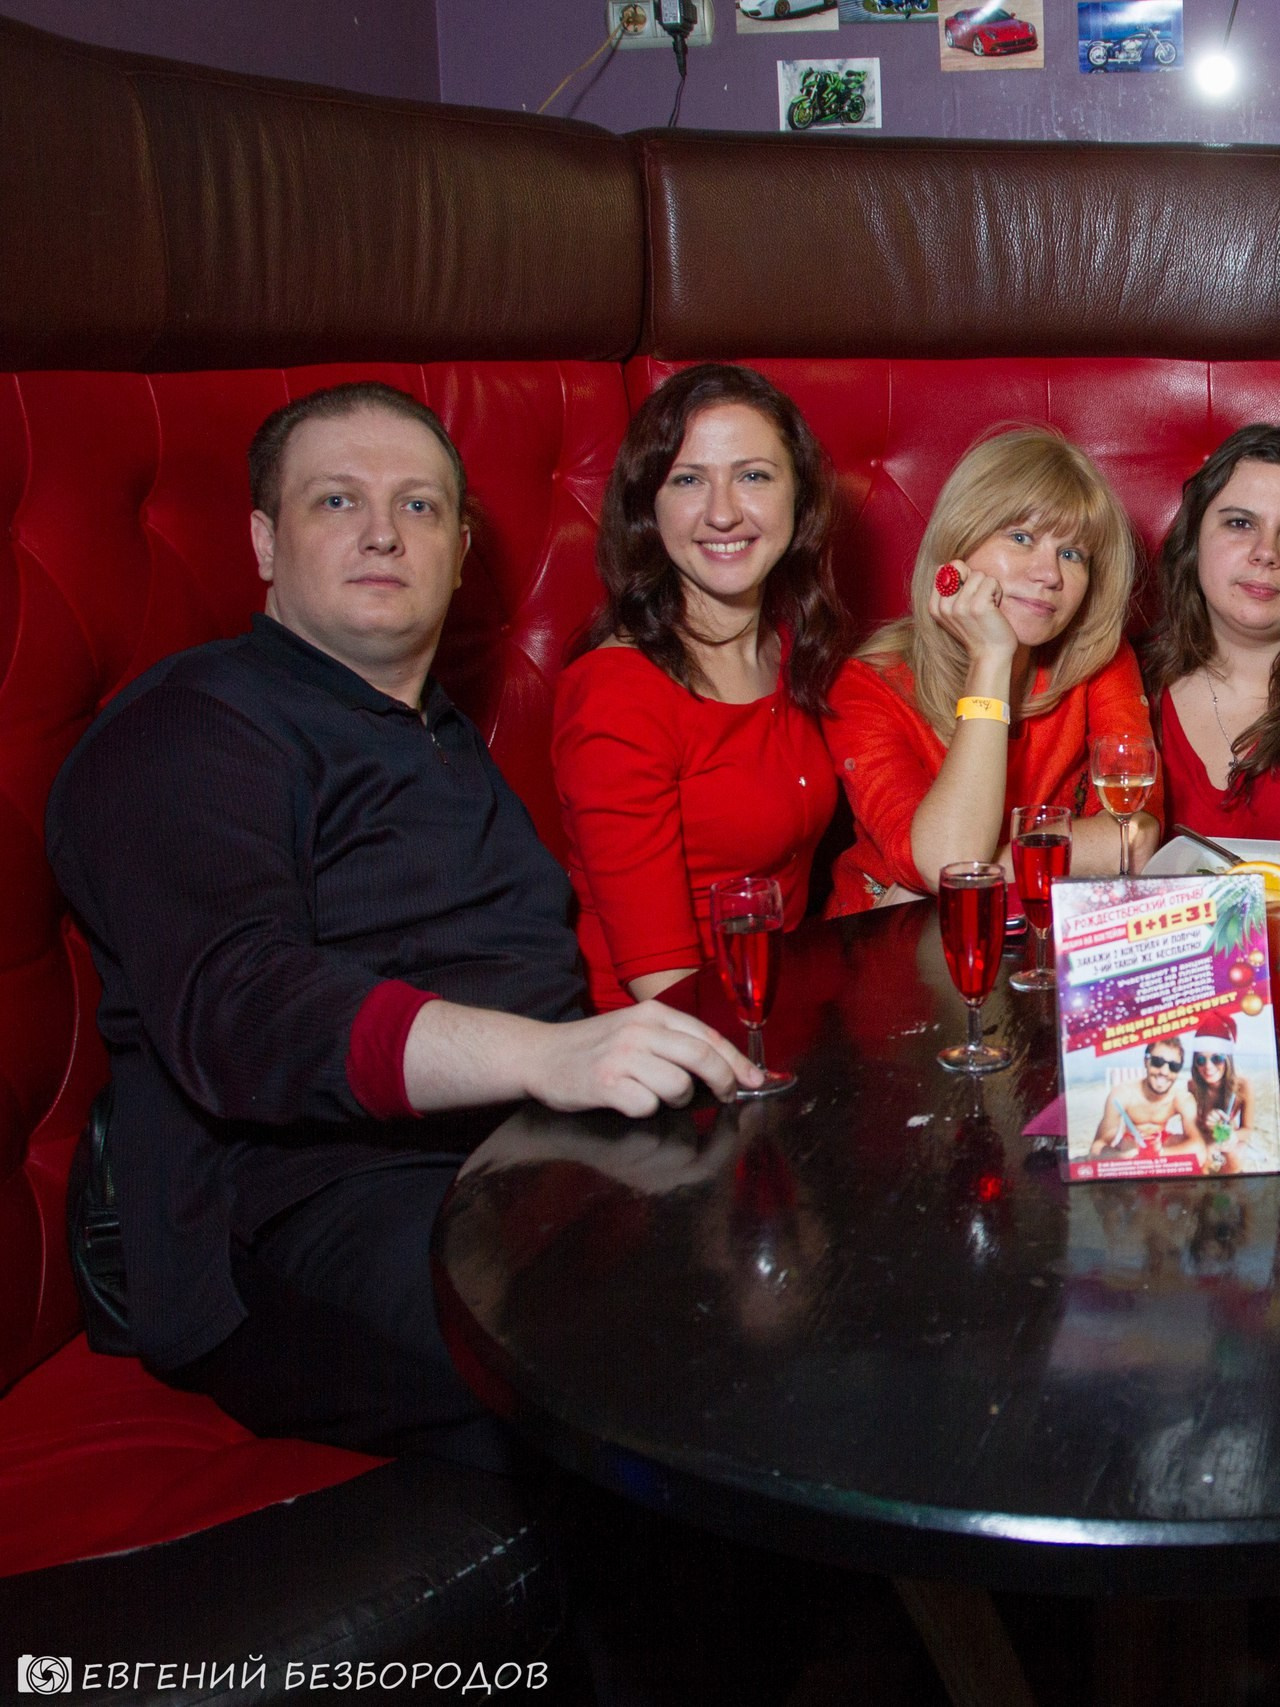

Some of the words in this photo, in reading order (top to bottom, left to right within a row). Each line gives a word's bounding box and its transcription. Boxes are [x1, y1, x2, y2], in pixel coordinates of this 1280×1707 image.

[1074, 898, 1166, 930] РОЖДЕСТВЕНСКИЙ
[1076, 950, 1111, 969] ЗАКАЖИ
[1114, 957, 1138, 972] ТАКОЙ
[1141, 954, 1152, 966] ЖЕ
[1105, 1015, 1155, 1039] АКЦИЯ
[1157, 991, 1238, 1023] ДЕЙСТВУЕТ
[1102, 1033, 1140, 1051] ВЕСЬ
[1142, 1016, 1200, 1040] ЯНВАРЬ
